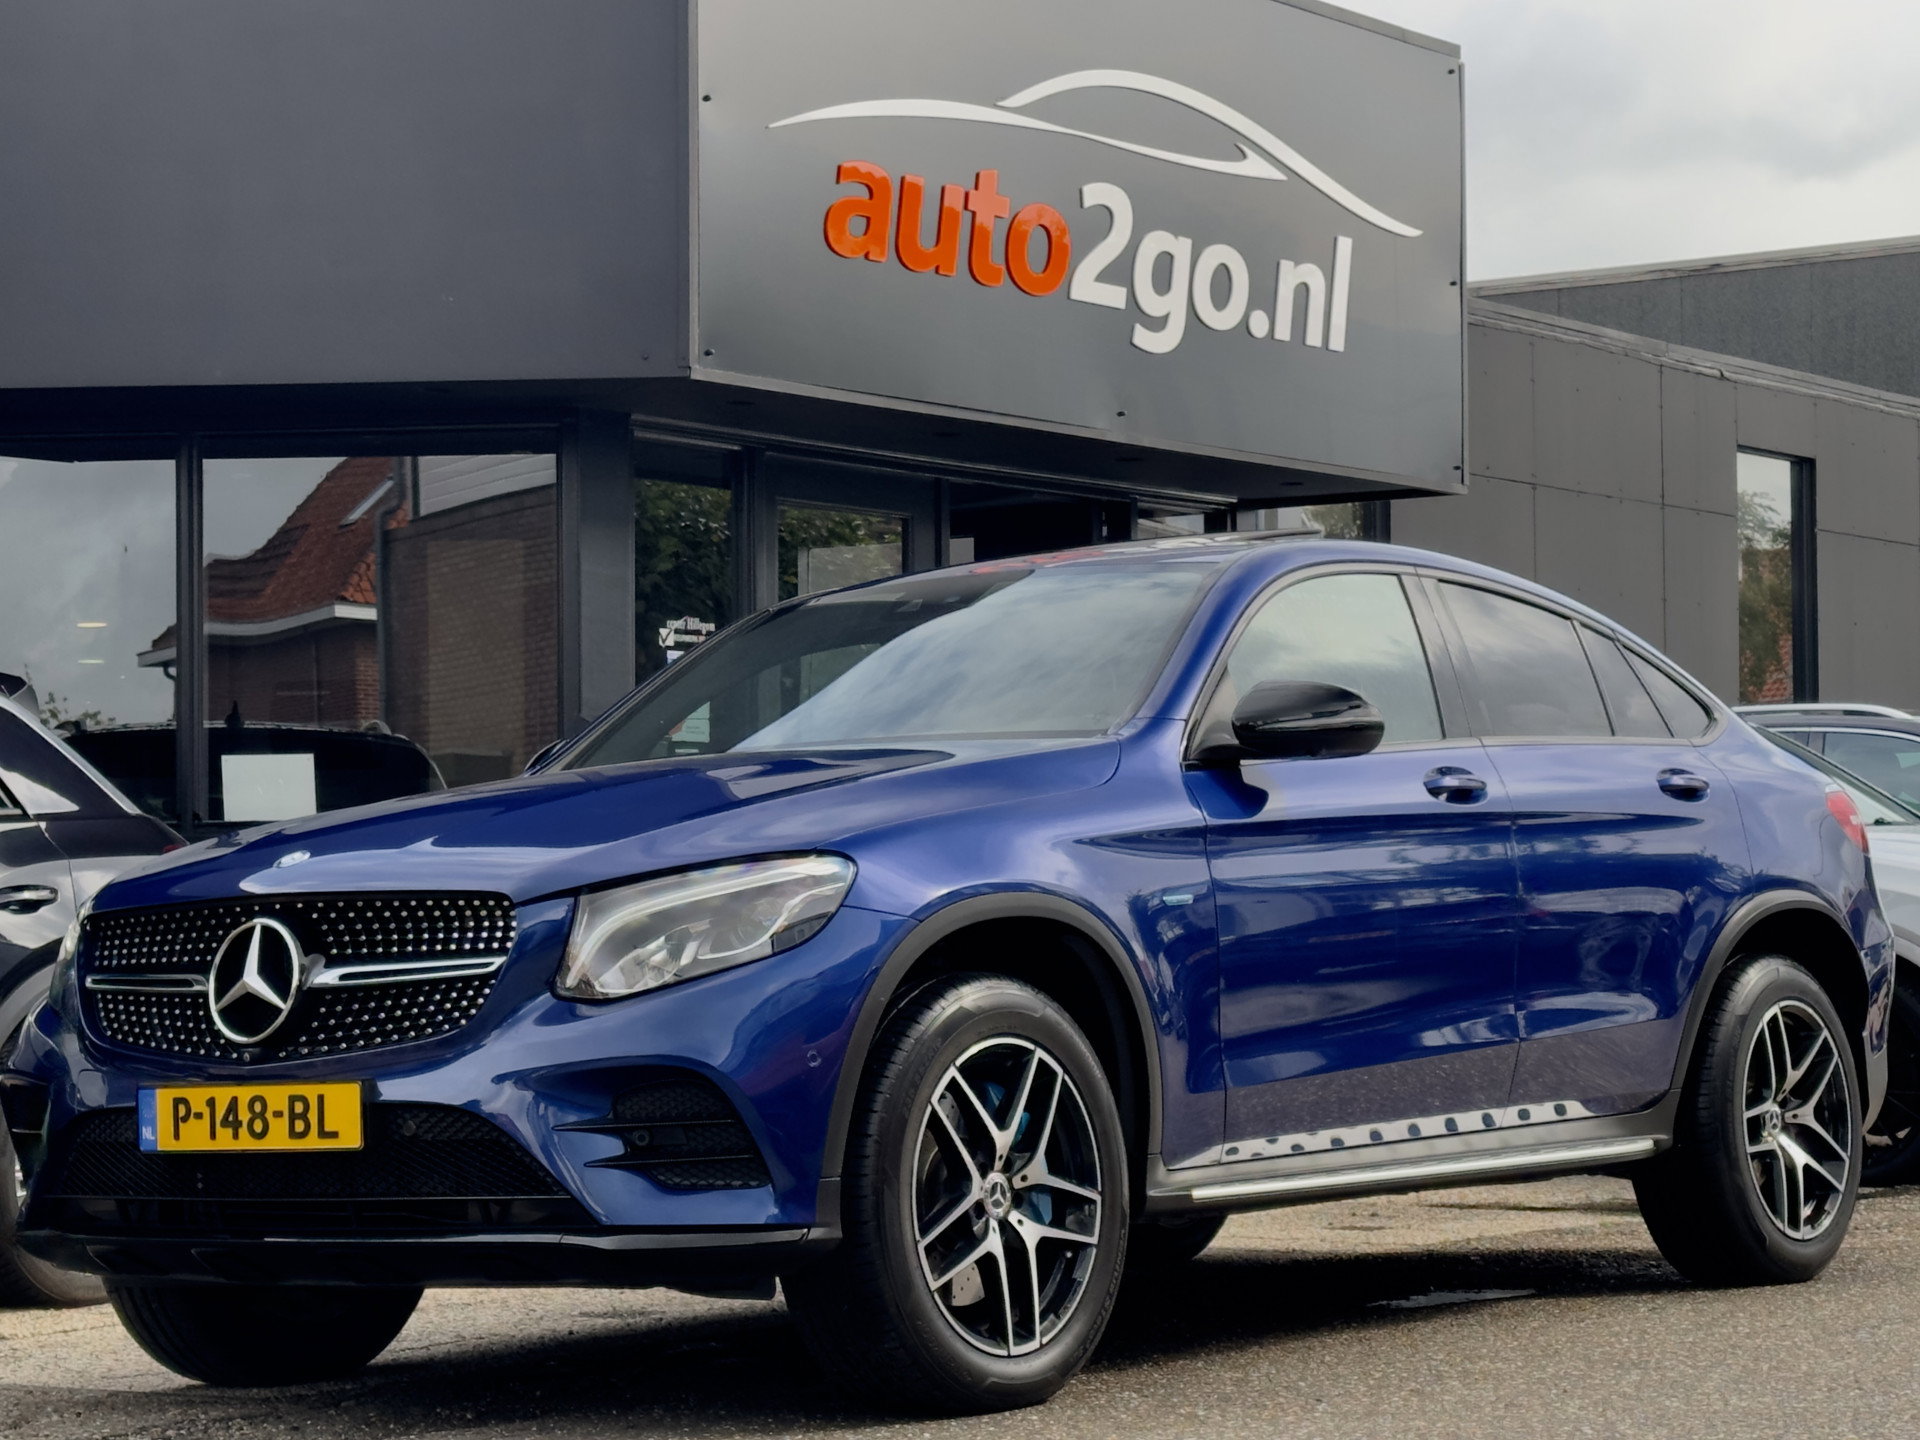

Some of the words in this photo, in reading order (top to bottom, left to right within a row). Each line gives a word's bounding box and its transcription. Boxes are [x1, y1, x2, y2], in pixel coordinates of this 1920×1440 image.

[823, 160, 1353, 354] auto2go.nl
[142, 1126, 155, 1140] NL
[172, 1093, 339, 1141] P-148-BL
